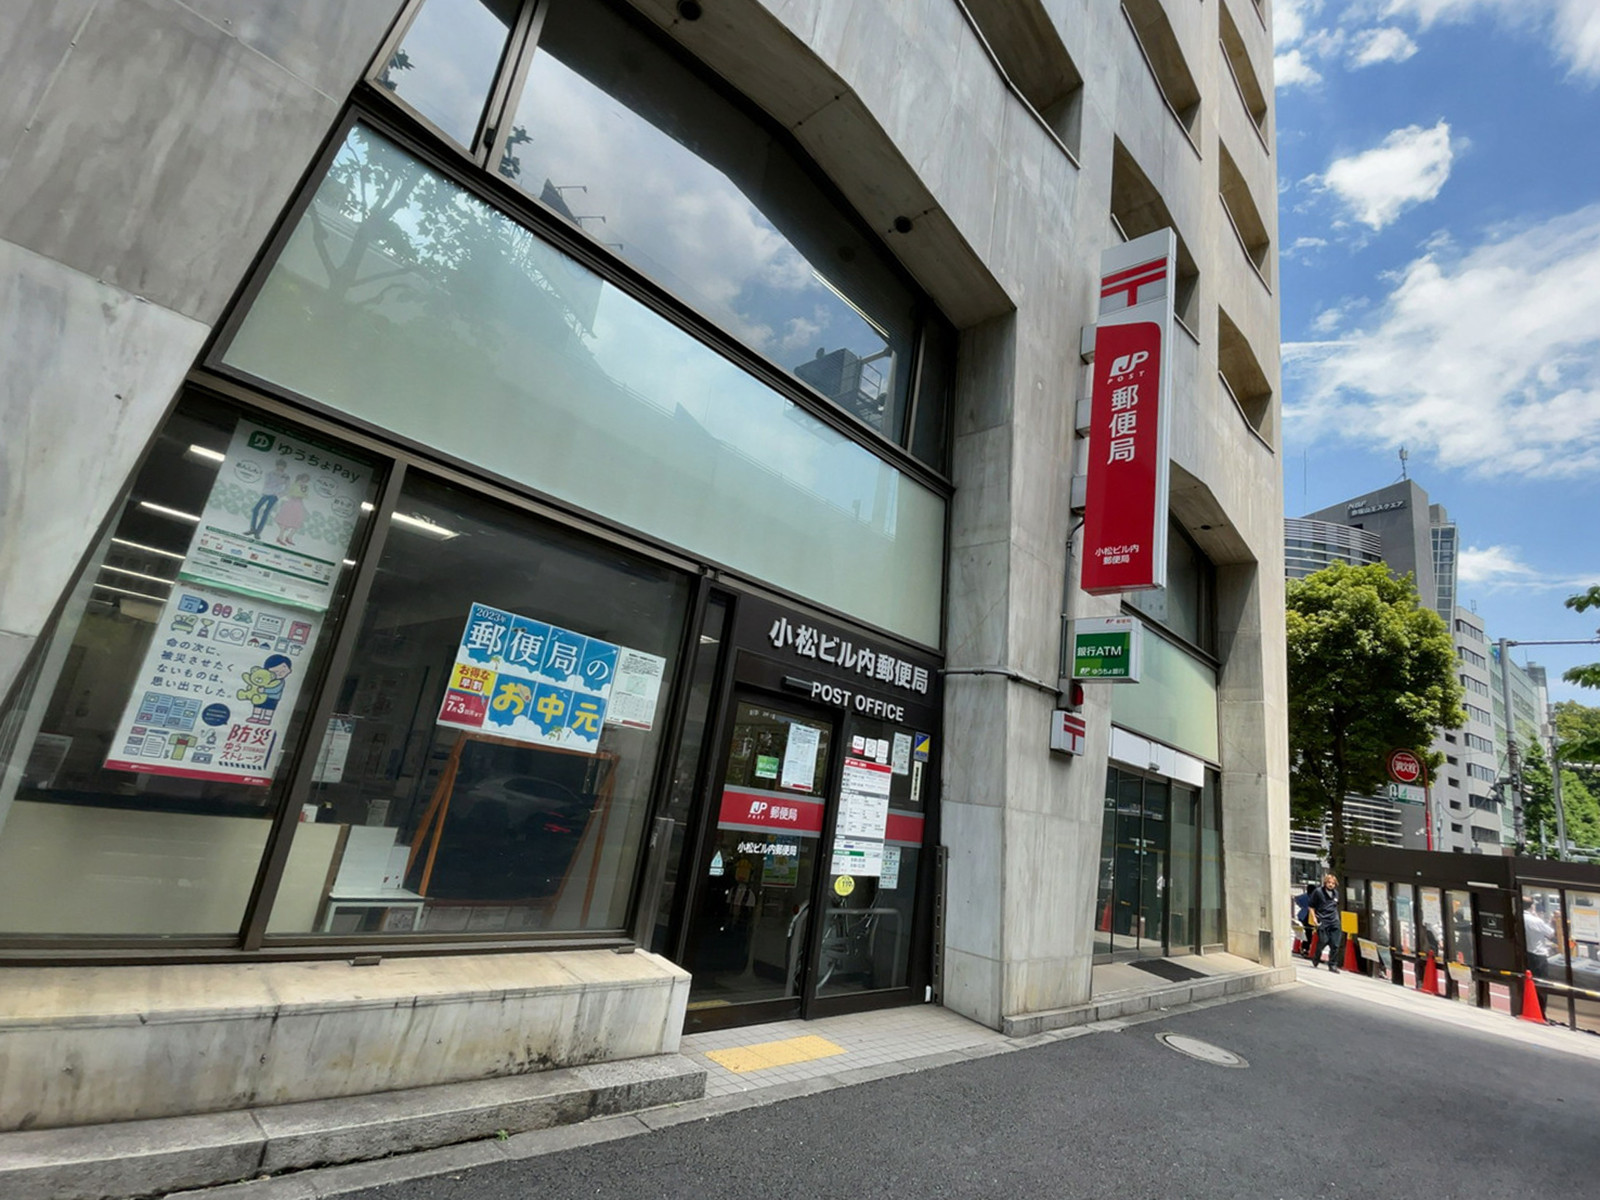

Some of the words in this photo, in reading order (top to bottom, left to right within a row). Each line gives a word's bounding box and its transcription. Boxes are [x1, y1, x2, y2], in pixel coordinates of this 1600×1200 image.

[1106, 370, 1145, 385] POST
[1106, 384, 1139, 465] 郵便局
[277, 441, 361, 484] ゆうちょPay
[1094, 543, 1140, 557] 小松ビル内
[1102, 554, 1131, 566] 郵便局
[475, 607, 507, 623] 2023年
[165, 637, 222, 657] 命の次に、
[466, 620, 610, 681] 郵便局の
[768, 616, 930, 695] 小松ビル内郵便局
[1076, 645, 1122, 657] 銀行ATM
[160, 650, 235, 673] 被災させたく
[459, 665, 491, 681] お得な
[492, 682, 600, 734] お中元
[811, 681, 852, 707] POST
[854, 694, 905, 722] OFFICE
[227, 723, 273, 747] 防災
[223, 742, 241, 752] ゆう
[770, 806, 798, 822] 郵便局
[737, 841, 798, 857] 小松ビル内郵便局
